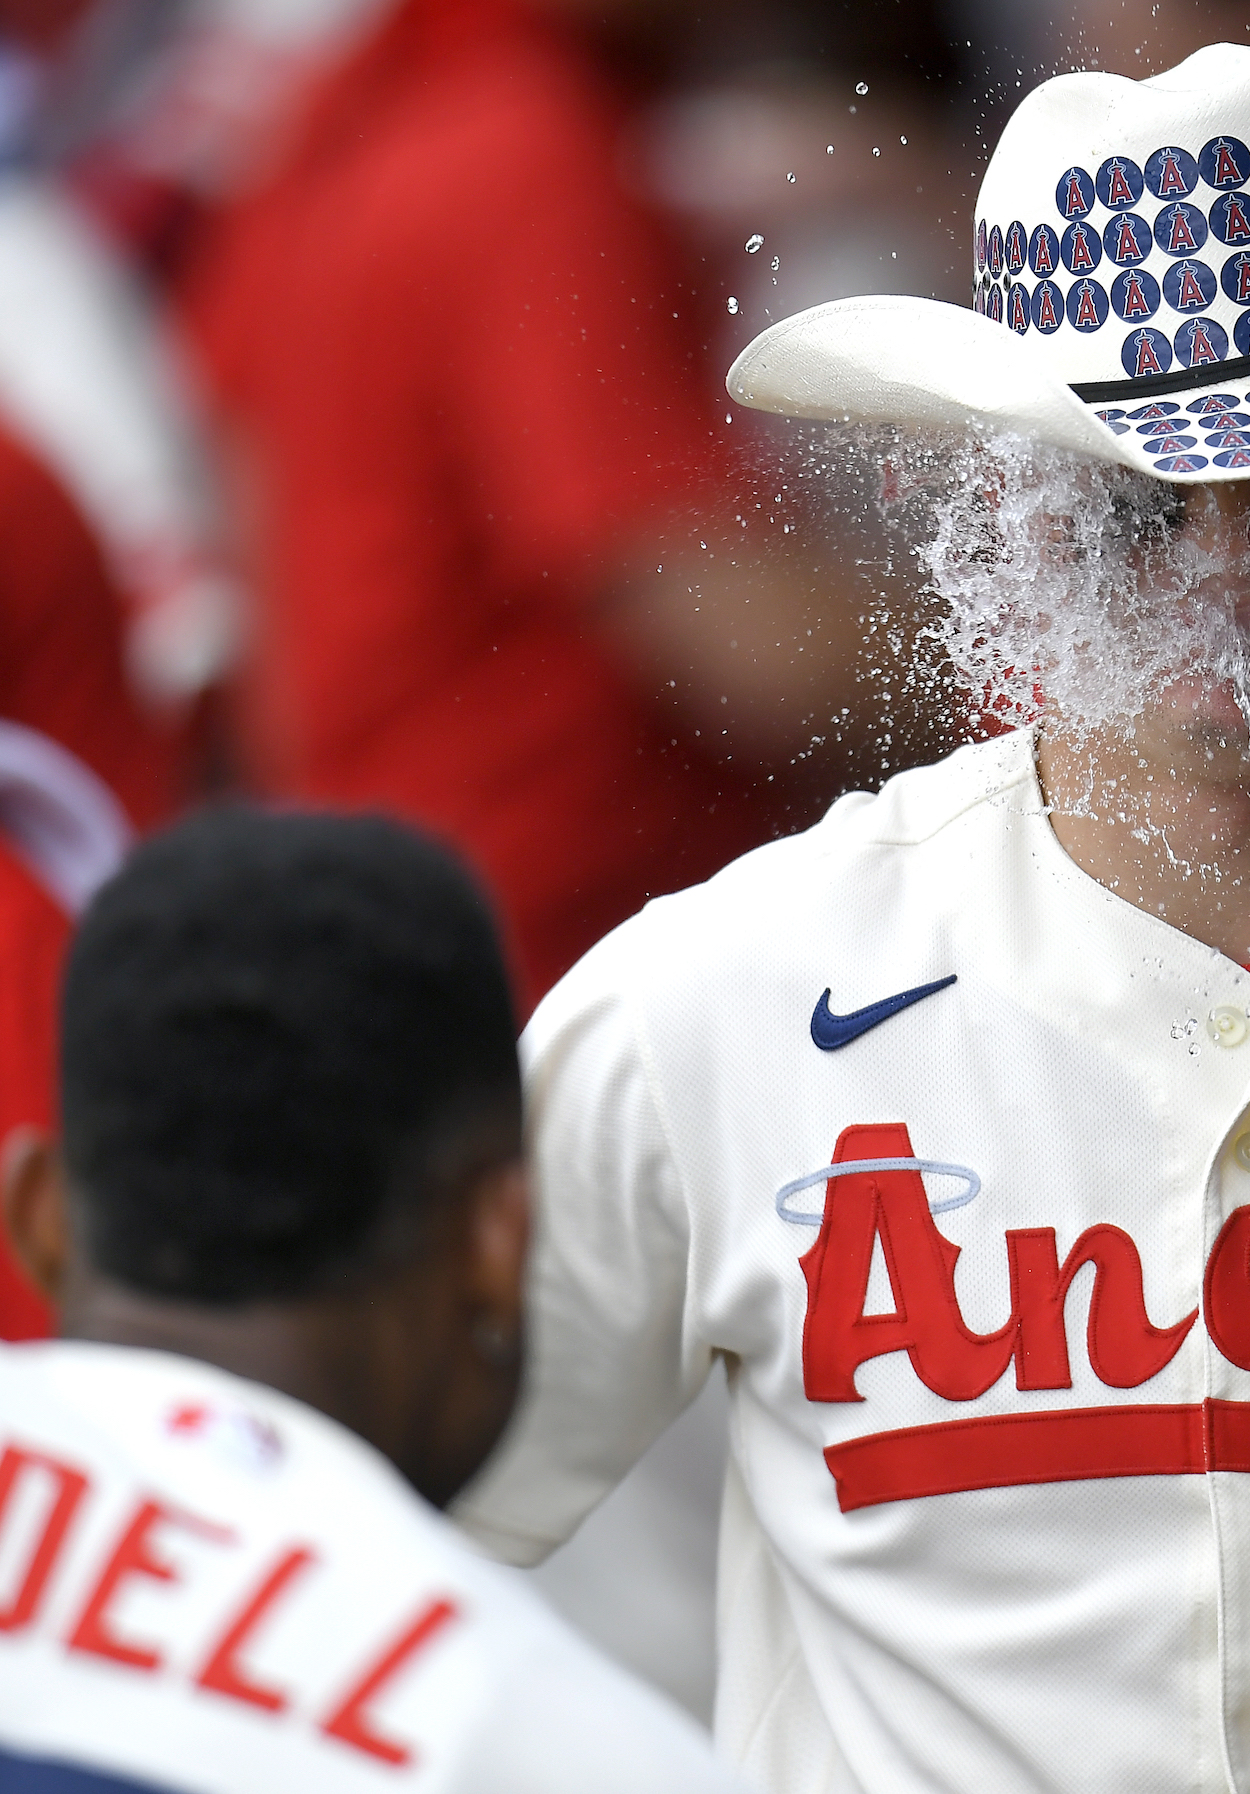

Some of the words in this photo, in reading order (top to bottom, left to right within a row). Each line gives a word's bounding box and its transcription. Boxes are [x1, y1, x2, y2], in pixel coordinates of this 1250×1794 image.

[1107, 159, 1135, 205] A
[1158, 148, 1188, 195] A
[1213, 138, 1244, 185] A
[1065, 169, 1089, 217] A
[991, 226, 1001, 272] A
[1009, 222, 1022, 269] A
[1034, 225, 1053, 272] A
[1070, 223, 1094, 269] A
[1115, 213, 1143, 262] A
[1167, 204, 1197, 252] A
[1012, 284, 1027, 331] A
[1039, 281, 1058, 328] A
[1075, 279, 1099, 326] A
[1123, 270, 1152, 317] A
[1176, 261, 1207, 309] A
[1134, 330, 1161, 377] A
[1187, 319, 1217, 366] A
